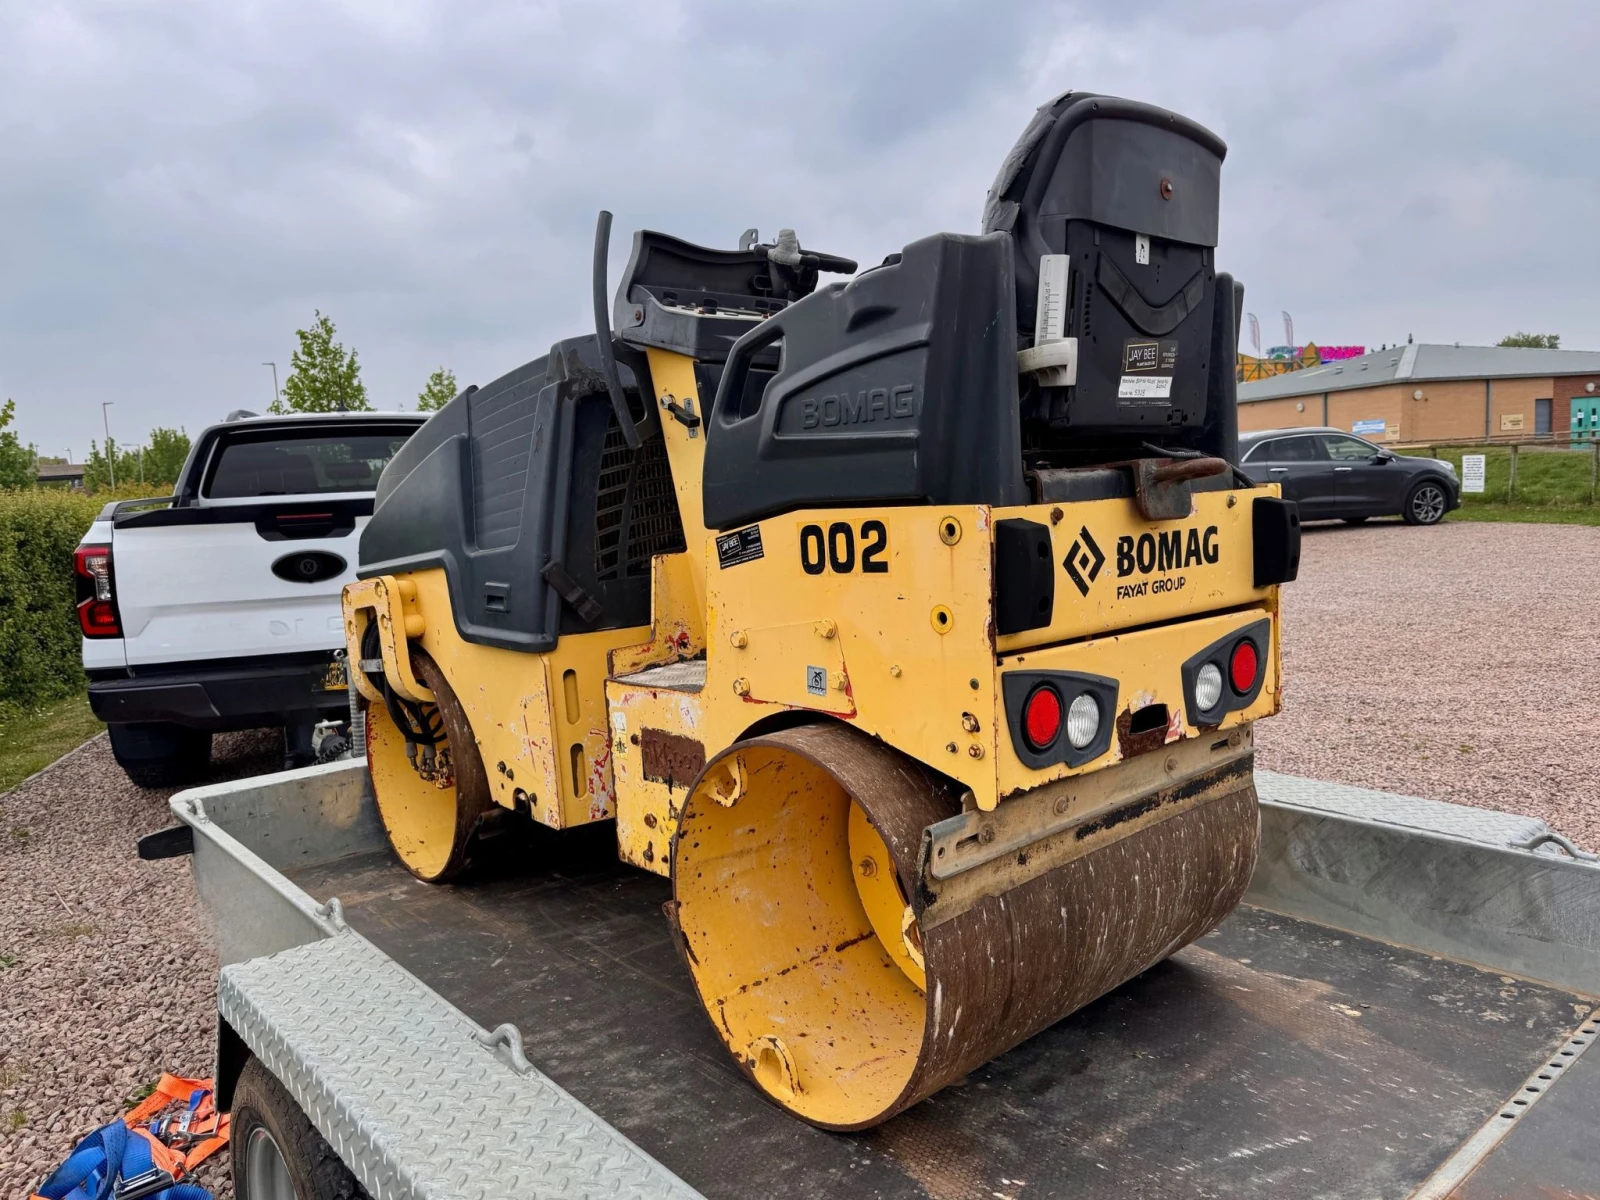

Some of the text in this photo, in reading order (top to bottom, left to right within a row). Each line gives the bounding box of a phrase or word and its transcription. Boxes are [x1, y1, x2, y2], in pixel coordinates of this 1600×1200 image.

[1129, 349, 1143, 361] JAY
[1144, 348, 1156, 360] BEE
[802, 384, 914, 429] BOMAG
[729, 538, 739, 548] BEE
[800, 520, 889, 575] 002
[1117, 525, 1218, 577] BOMAG
[1117, 577, 1186, 600] FAYAT GROUP
